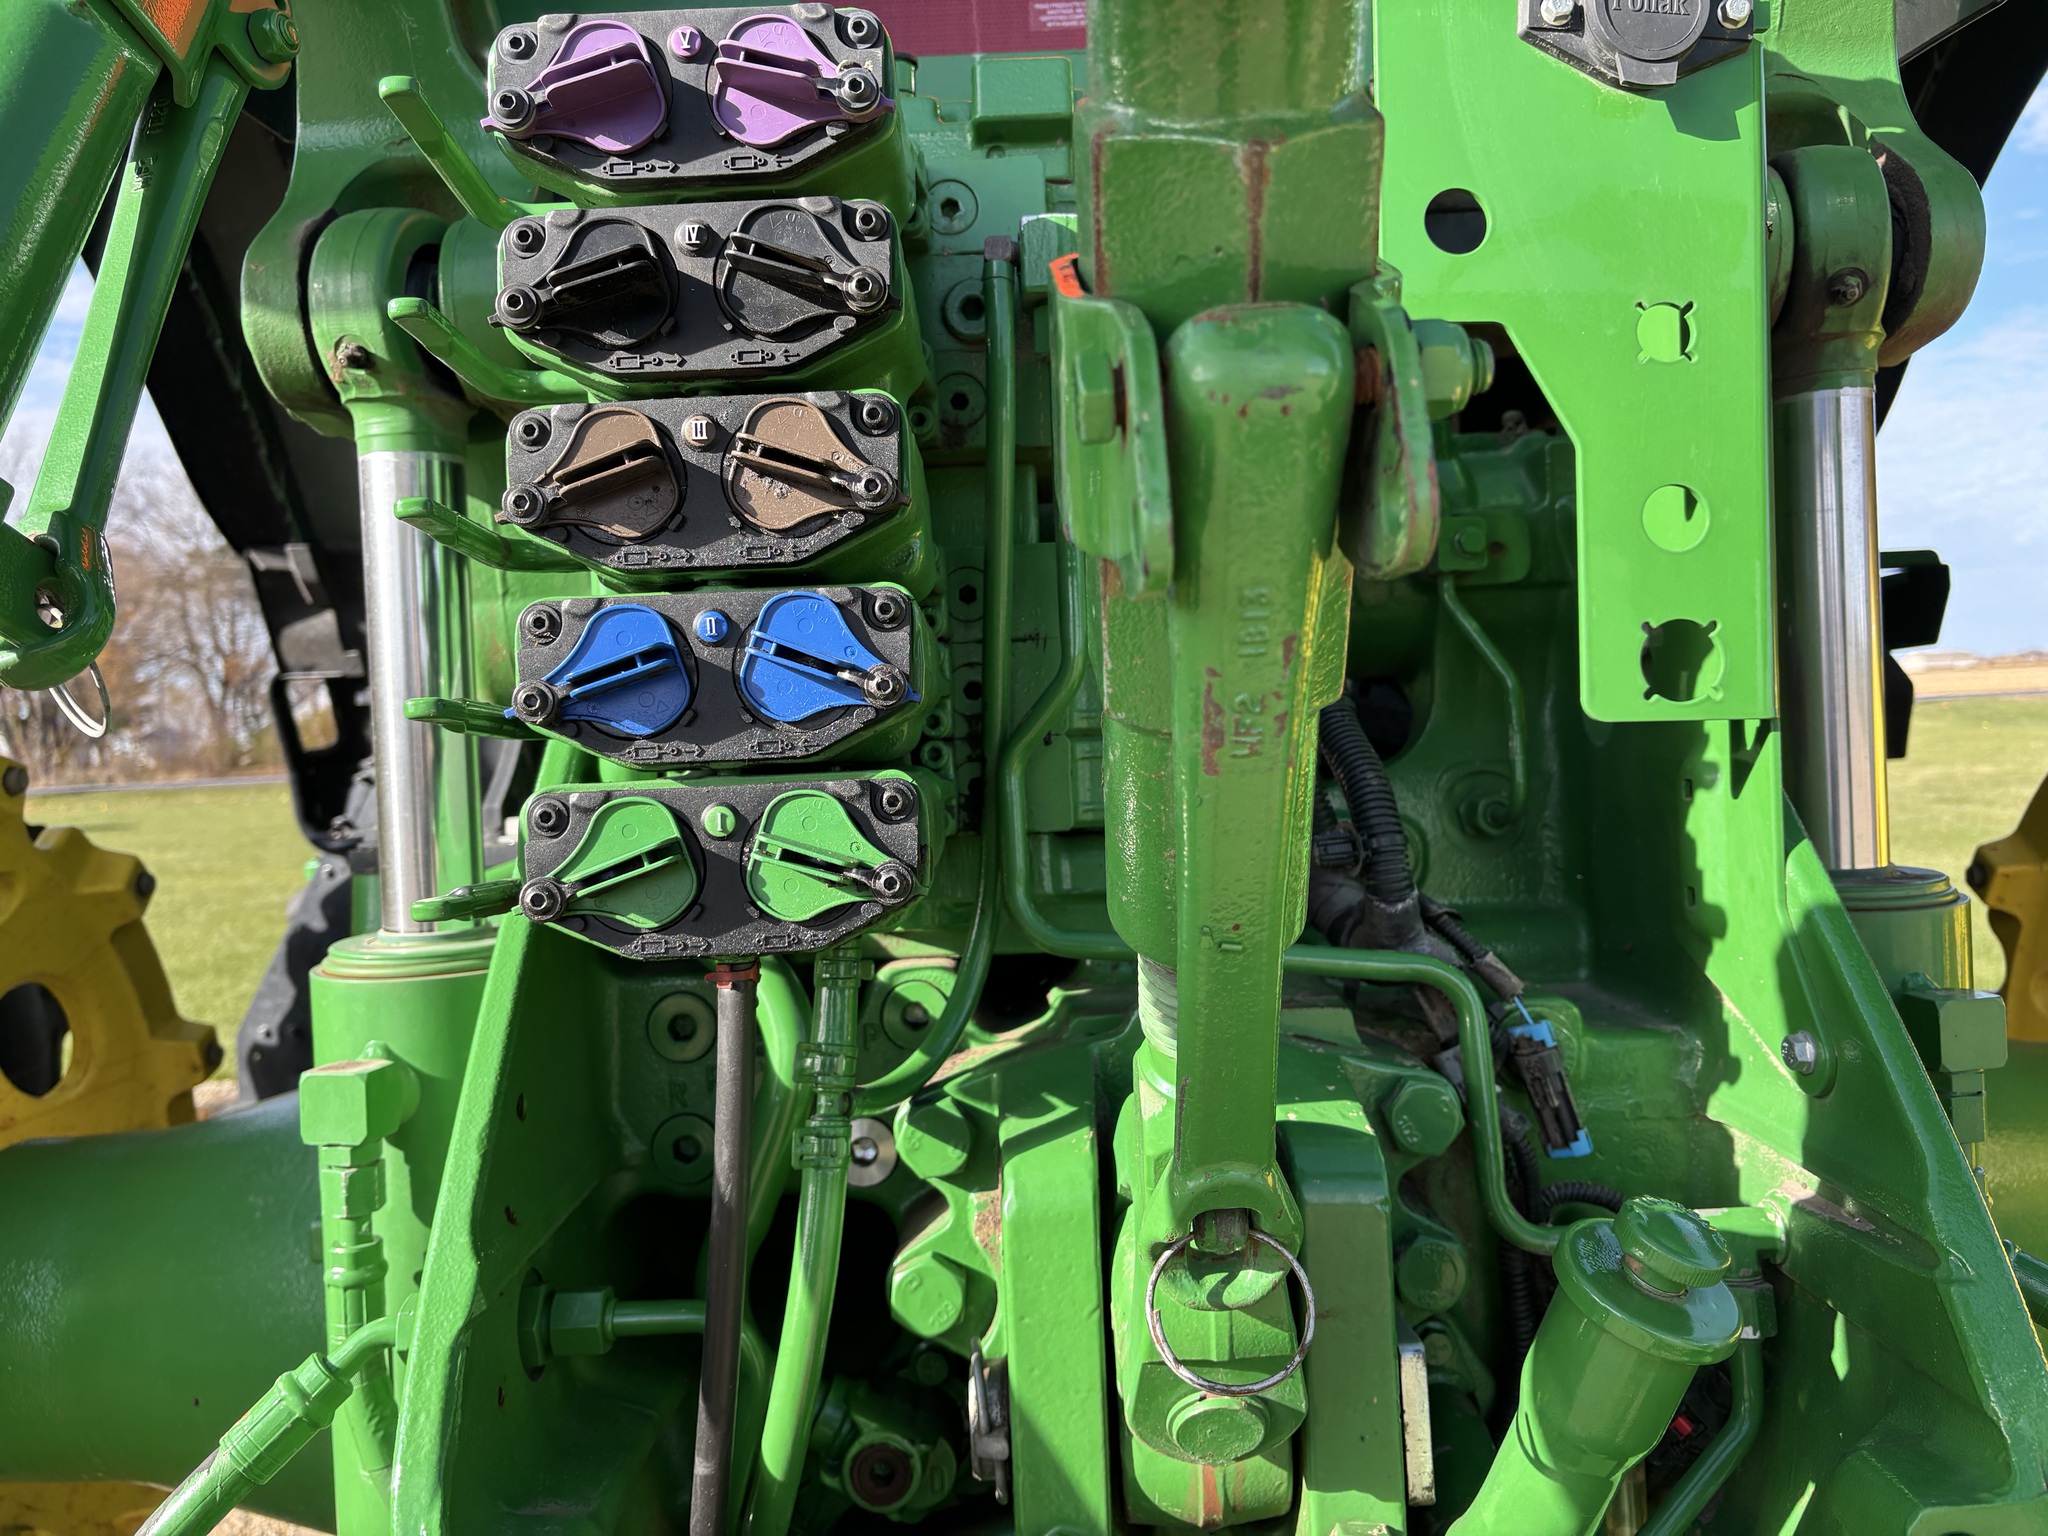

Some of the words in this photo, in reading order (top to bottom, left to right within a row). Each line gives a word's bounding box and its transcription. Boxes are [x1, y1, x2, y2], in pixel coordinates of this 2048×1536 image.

[677, 29, 691, 49] V
[685, 225, 701, 244] IV
[691, 420, 708, 440] III
[704, 617, 718, 637] II
